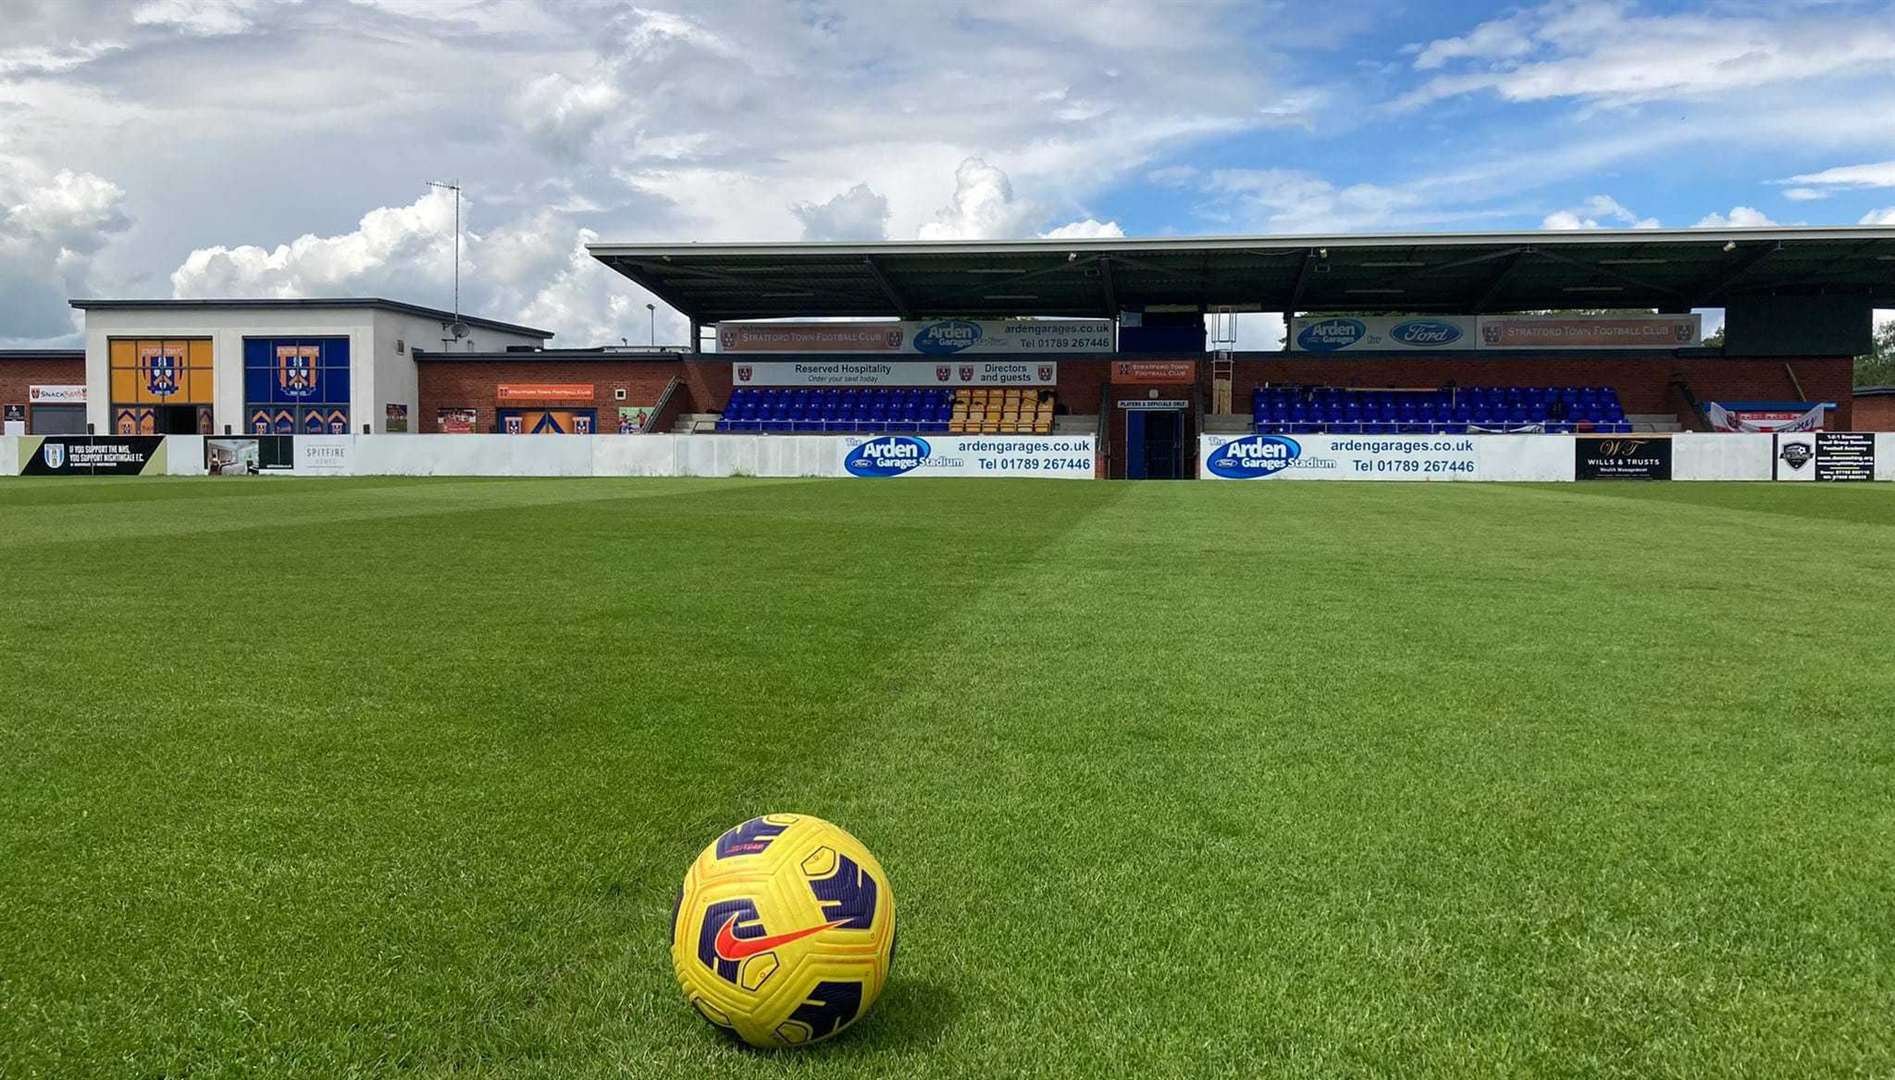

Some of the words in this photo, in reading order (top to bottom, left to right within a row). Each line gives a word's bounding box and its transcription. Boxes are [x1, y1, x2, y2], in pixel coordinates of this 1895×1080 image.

[928, 322, 972, 338] Arden
[1004, 323, 1109, 335] ardengarages.co.uk
[1312, 320, 1355, 336] Arden
[1404, 323, 1449, 341] Ford
[1507, 327, 1562, 337] STRATFORD
[1563, 327, 1593, 336] TOWN
[1594, 326, 1641, 336] FOOTBALL
[1643, 325, 1669, 335] CLUB
[741, 332, 789, 342] STRATFORD
[790, 332, 815, 342] TOWN
[816, 332, 858, 342] FOOTBALL
[858, 331, 882, 341] CLUB
[1020, 338, 1035, 348] Tel
[1038, 338, 1068, 348] 01789
[1072, 338, 1109, 348] 267446
[795, 364, 839, 374] Reserved
[841, 364, 892, 375] Hospitality
[984, 364, 1027, 373] Directors
[808, 375, 827, 383] Order
[828, 376, 843, 384] your
[980, 373, 998, 382] and
[1000, 373, 1031, 383] guests
[306, 447, 345, 458] SPITFIRE
[863, 437, 918, 458] Arden
[958, 439, 1090, 454] ardengarages.co.uk
[1227, 437, 1287, 458] Arden
[1330, 439, 1473, 454] ardengarages.co.uk
[877, 457, 918, 469] Garages
[919, 457, 963, 467] Stadium
[979, 458, 997, 470] Tel
[1001, 458, 1039, 470] 01789
[1043, 458, 1091, 470] 267446
[1241, 458, 1286, 470] Garages
[1287, 457, 1337, 468] Stadium
[1353, 460, 1373, 472] Tel
[1377, 460, 1419, 472] 01789
[1424, 460, 1475, 472] 267446
